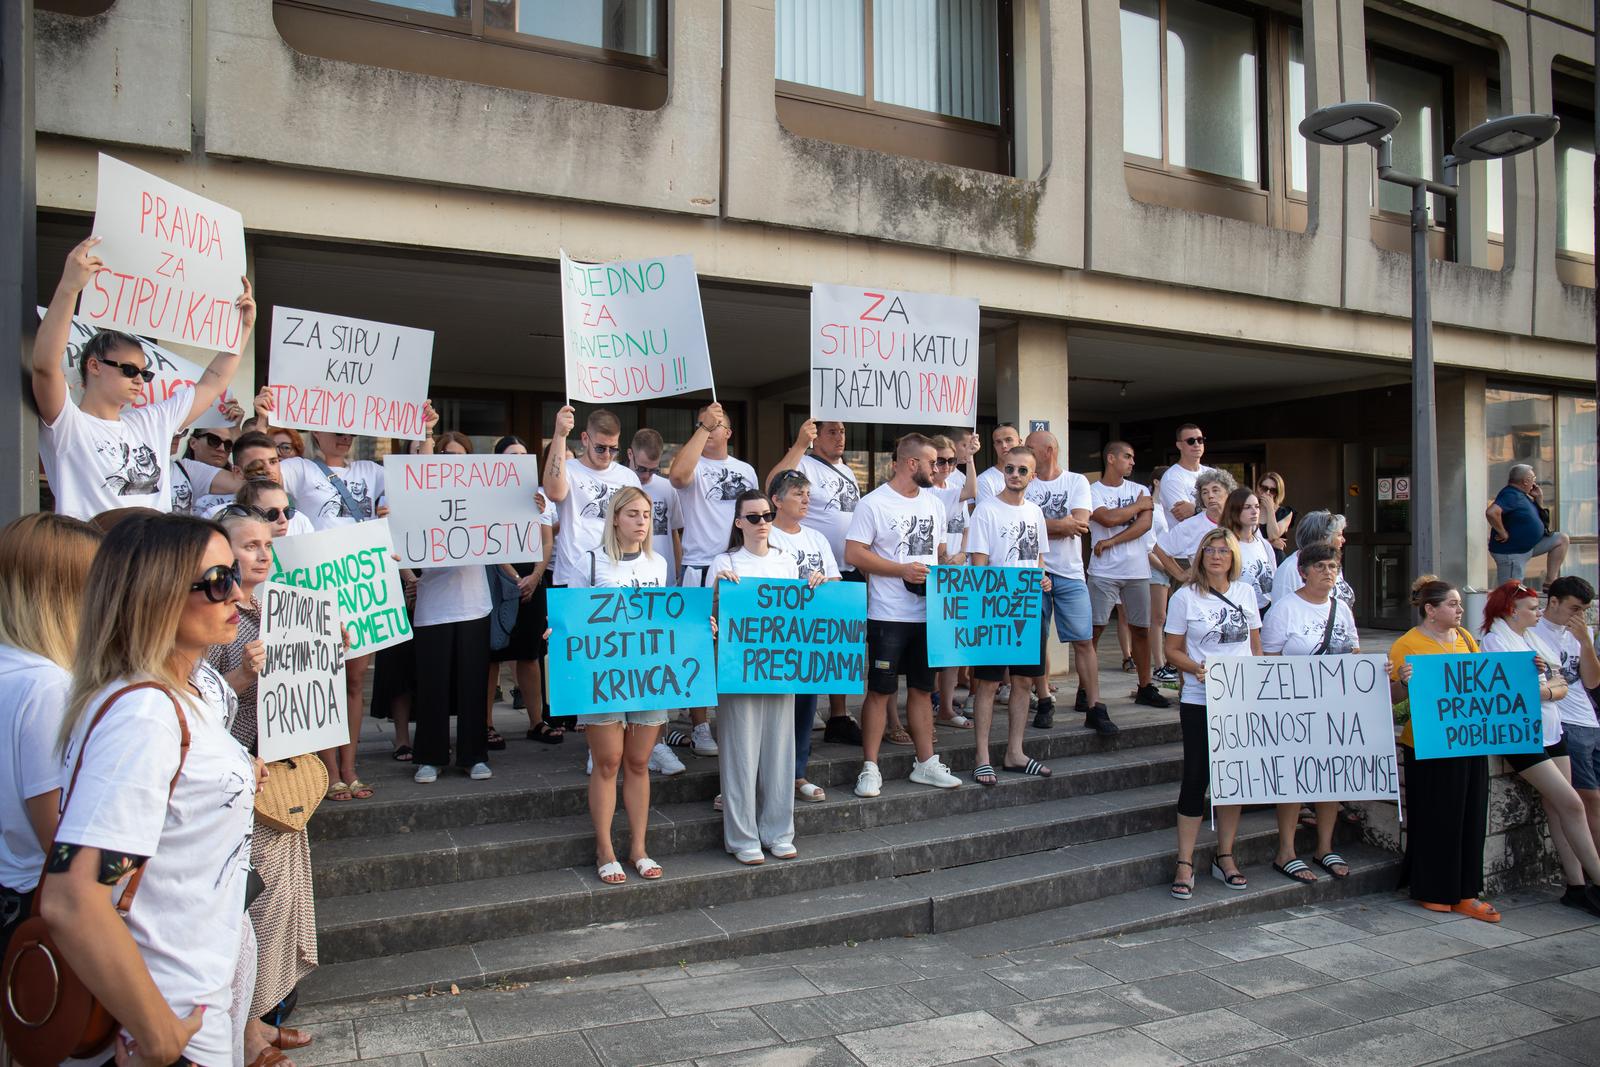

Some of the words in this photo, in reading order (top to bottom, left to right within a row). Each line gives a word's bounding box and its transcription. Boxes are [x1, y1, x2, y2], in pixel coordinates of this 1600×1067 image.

[141, 191, 223, 260] PRAVDA
[156, 251, 185, 281] ZA
[90, 267, 171, 328] STIPU
[172, 290, 183, 332] I
[182, 291, 243, 348] KATU
[859, 292, 909, 324] ZA
[282, 316, 322, 349] ZA
[330, 325, 380, 356] STIPU
[392, 336, 400, 360] I
[821, 323, 895, 360] STIPU
[902, 333, 907, 361] I
[912, 332, 969, 367] KATU
[325, 358, 373, 385] KATU
[812, 363, 912, 410] TRAŽIMO
[919, 372, 977, 416] PRAVDU
[270, 384, 355, 428] TRAŽIMO
[363, 395, 425, 435] PRAVDU
[405, 462, 520, 490] NEPRAVDA
[440, 499, 467, 521] JE
[406, 521, 541, 562] UBOJSTVO
[757, 583, 815, 610] STOP
[937, 568, 1008, 594] PRAVDA
[1017, 570, 1042, 594] SE
[267, 589, 313, 633] PRITVOR
[316, 600, 332, 636] NE
[587, 588, 685, 624] ZAŠTO
[943, 596, 968, 620] NE
[982, 588, 1037, 619] MOŽE
[566, 629, 675, 661] PUSTITI
[728, 615, 867, 644] NEPRAVEDNIM
[955, 620, 1027, 649] KUPITI!
[331, 642, 344, 675] JE
[742, 647, 864, 683] PRESUDAMA
[1444, 658, 1510, 695] NEKA
[593, 657, 701, 704] KRIVCA?
[1209, 662, 1245, 701] SVI
[1256, 658, 1376, 700] ŽELIMO
[263, 678, 341, 738] PRAVDA
[1437, 692, 1528, 721] PRAVDA
[1210, 711, 1317, 753] SIGURNOST
[1327, 711, 1365, 746] NA
[1293, 754, 1398, 794] KOMPROMISE
